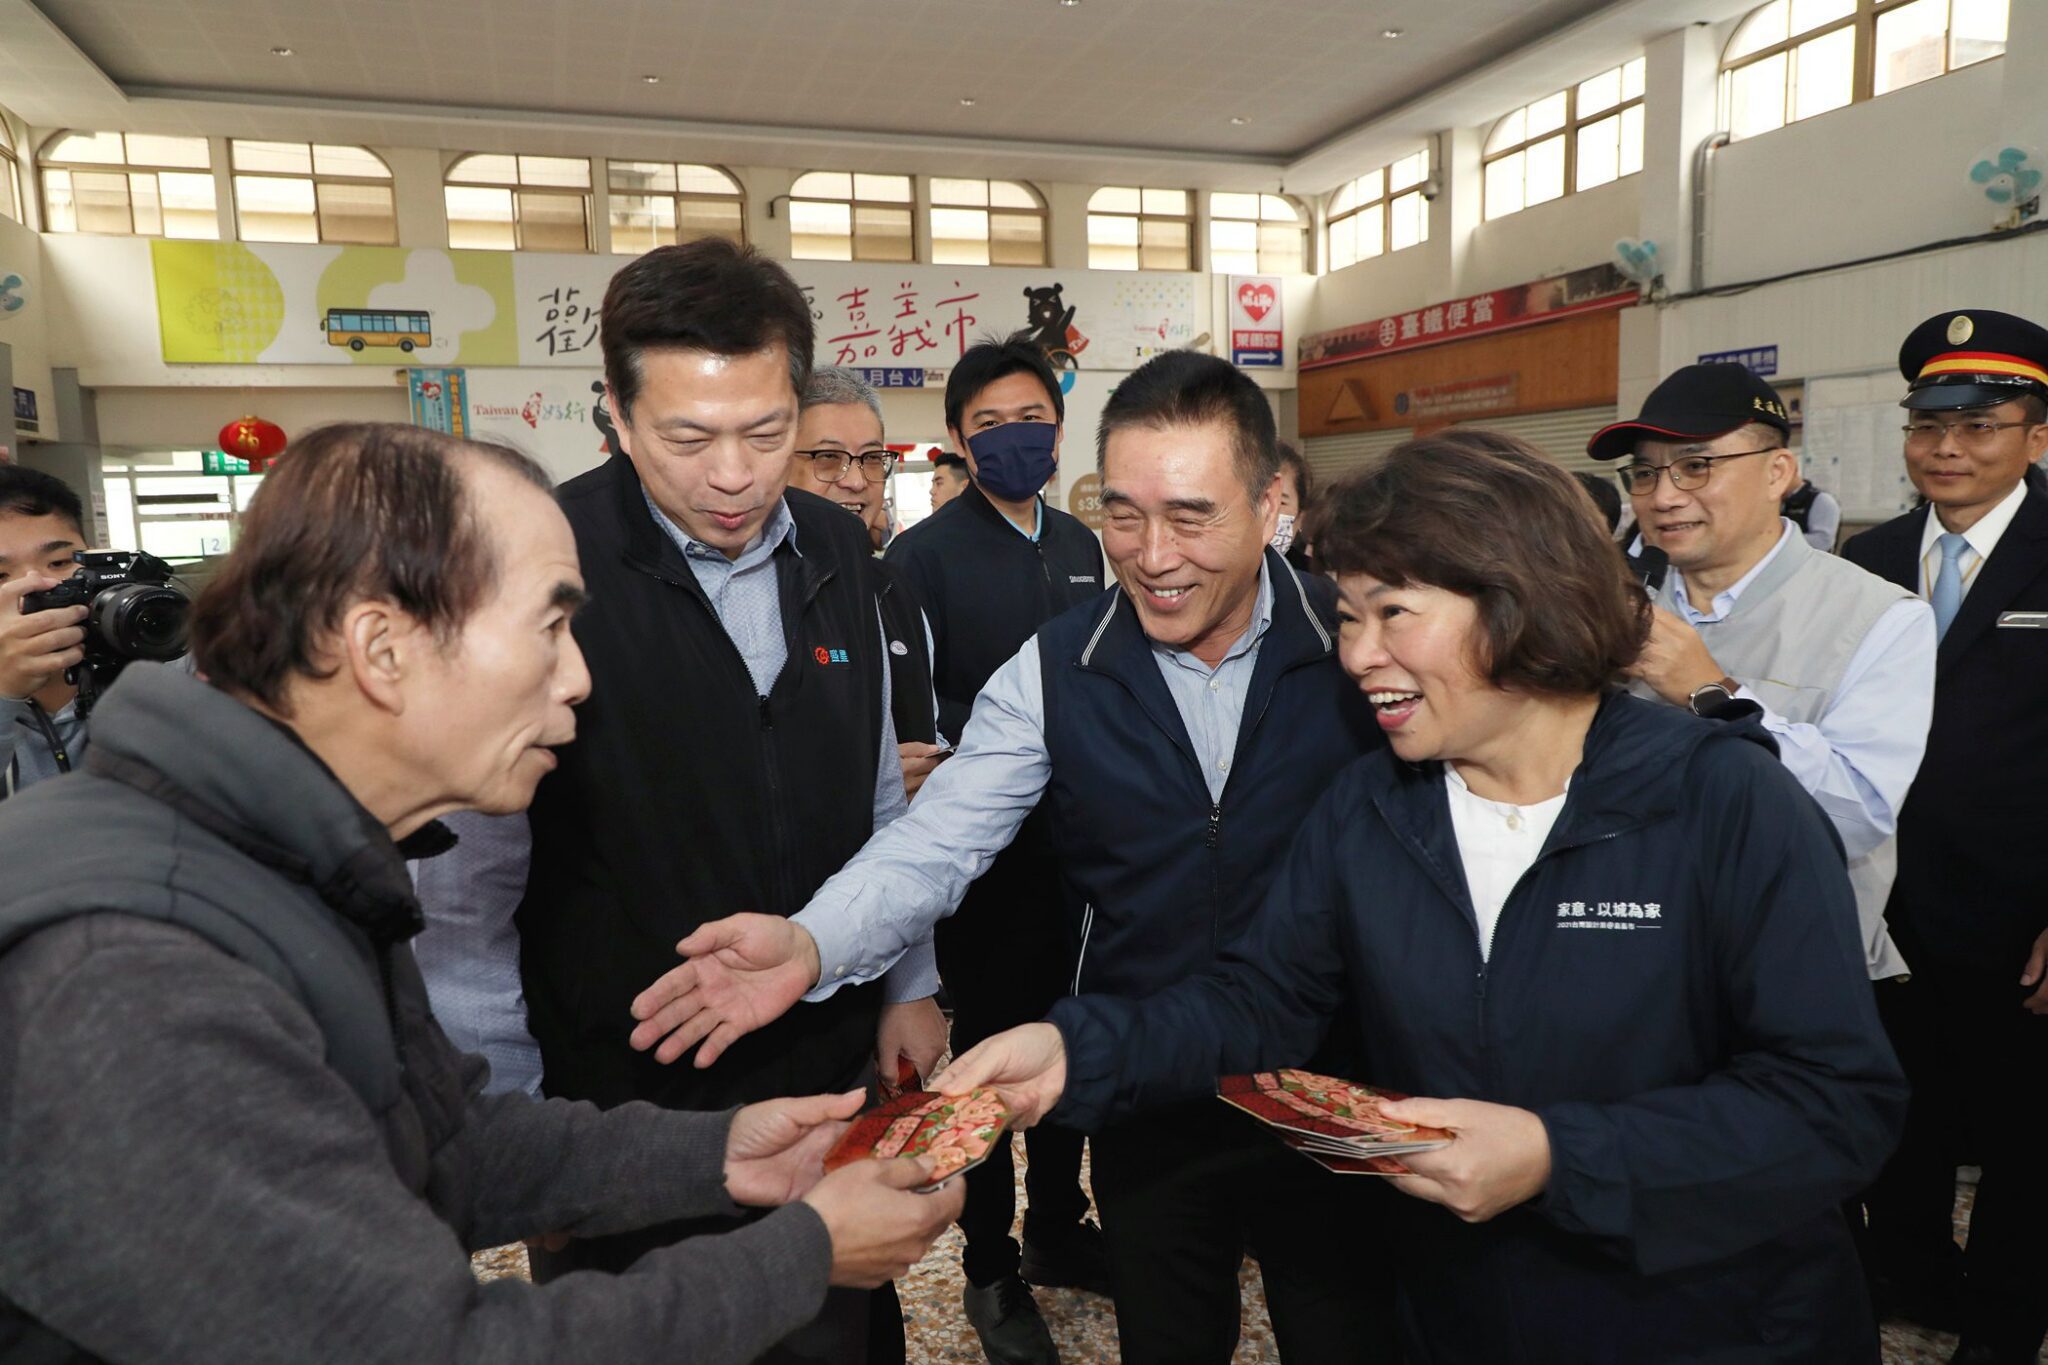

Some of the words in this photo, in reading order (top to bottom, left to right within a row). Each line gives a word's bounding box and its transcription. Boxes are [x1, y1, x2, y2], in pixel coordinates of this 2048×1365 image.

[1399, 294, 1495, 340] 臺鐵便當
[473, 403, 519, 416] Taiwan
[211, 538, 221, 551] 2
